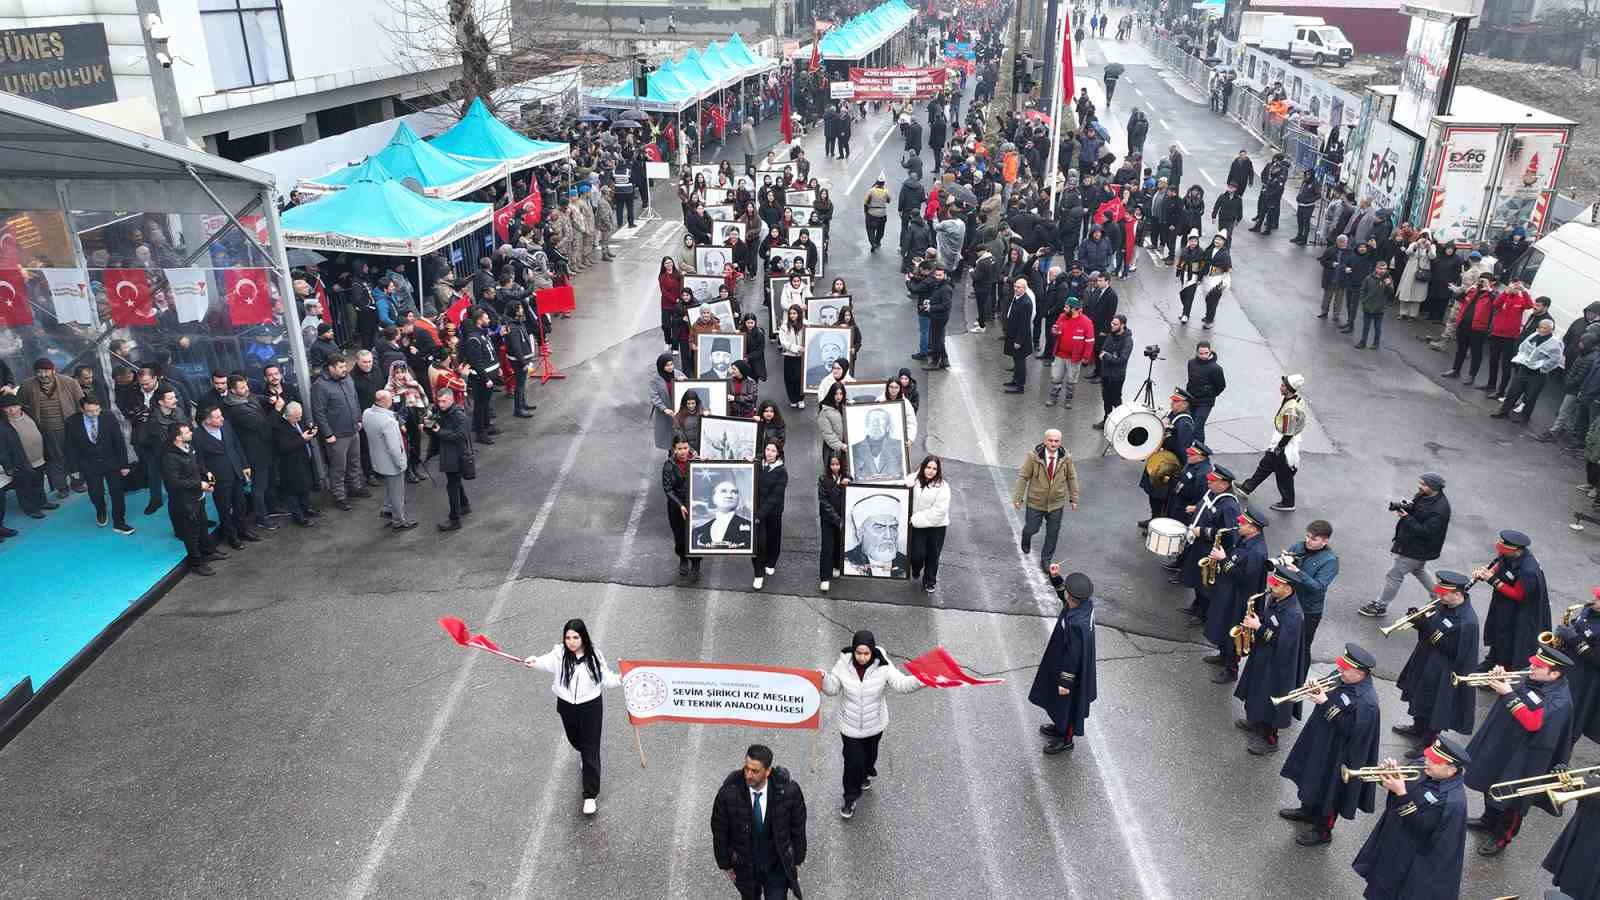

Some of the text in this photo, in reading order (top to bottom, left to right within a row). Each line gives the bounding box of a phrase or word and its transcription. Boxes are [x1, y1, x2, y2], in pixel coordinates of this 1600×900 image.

[1450, 149, 1486, 163] EXPO
[1368, 147, 1396, 194] EXPO
[672, 687, 703, 697] SEVİM
[744, 691, 760, 700] KIZ
[763, 692, 804, 704] MESLEKİ
[673, 699, 804, 714] VE TEKNİK ANADOLU LİSESİ
